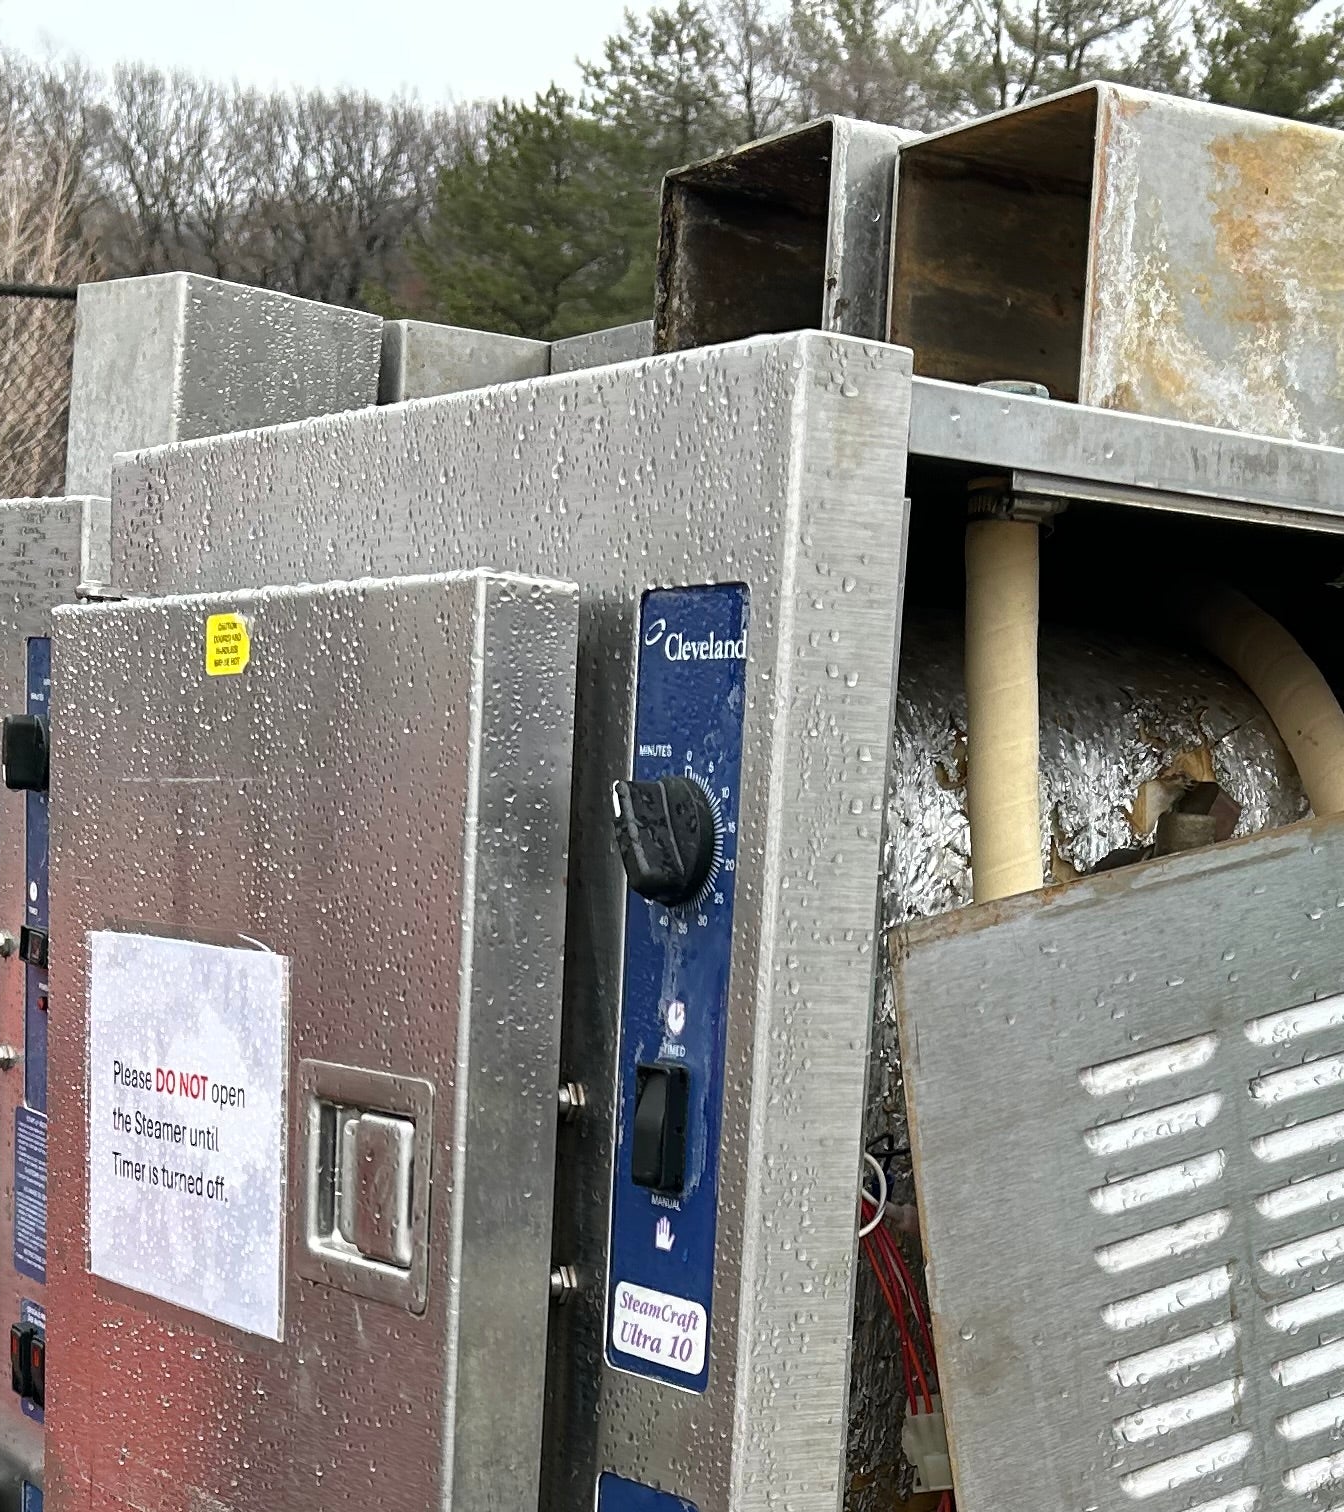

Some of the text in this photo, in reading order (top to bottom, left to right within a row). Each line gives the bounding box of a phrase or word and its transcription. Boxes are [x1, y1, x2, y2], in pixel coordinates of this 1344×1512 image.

[665, 630, 748, 661] Cleveland
[640, 745, 672, 757] MINUTES
[721, 786, 729, 799] 10
[725, 859, 734, 871] 20
[698, 914, 707, 927] 30
[113, 1060, 246, 1109] Please DO NOT open
[113, 1108, 220, 1152] the Steamer until
[112, 1151, 229, 1203] Timer is turned off.
[651, 1194, 681, 1212] MANUAL
[620, 1290, 699, 1333] SteamCraft
[621, 1320, 693, 1362] Ultra 10
